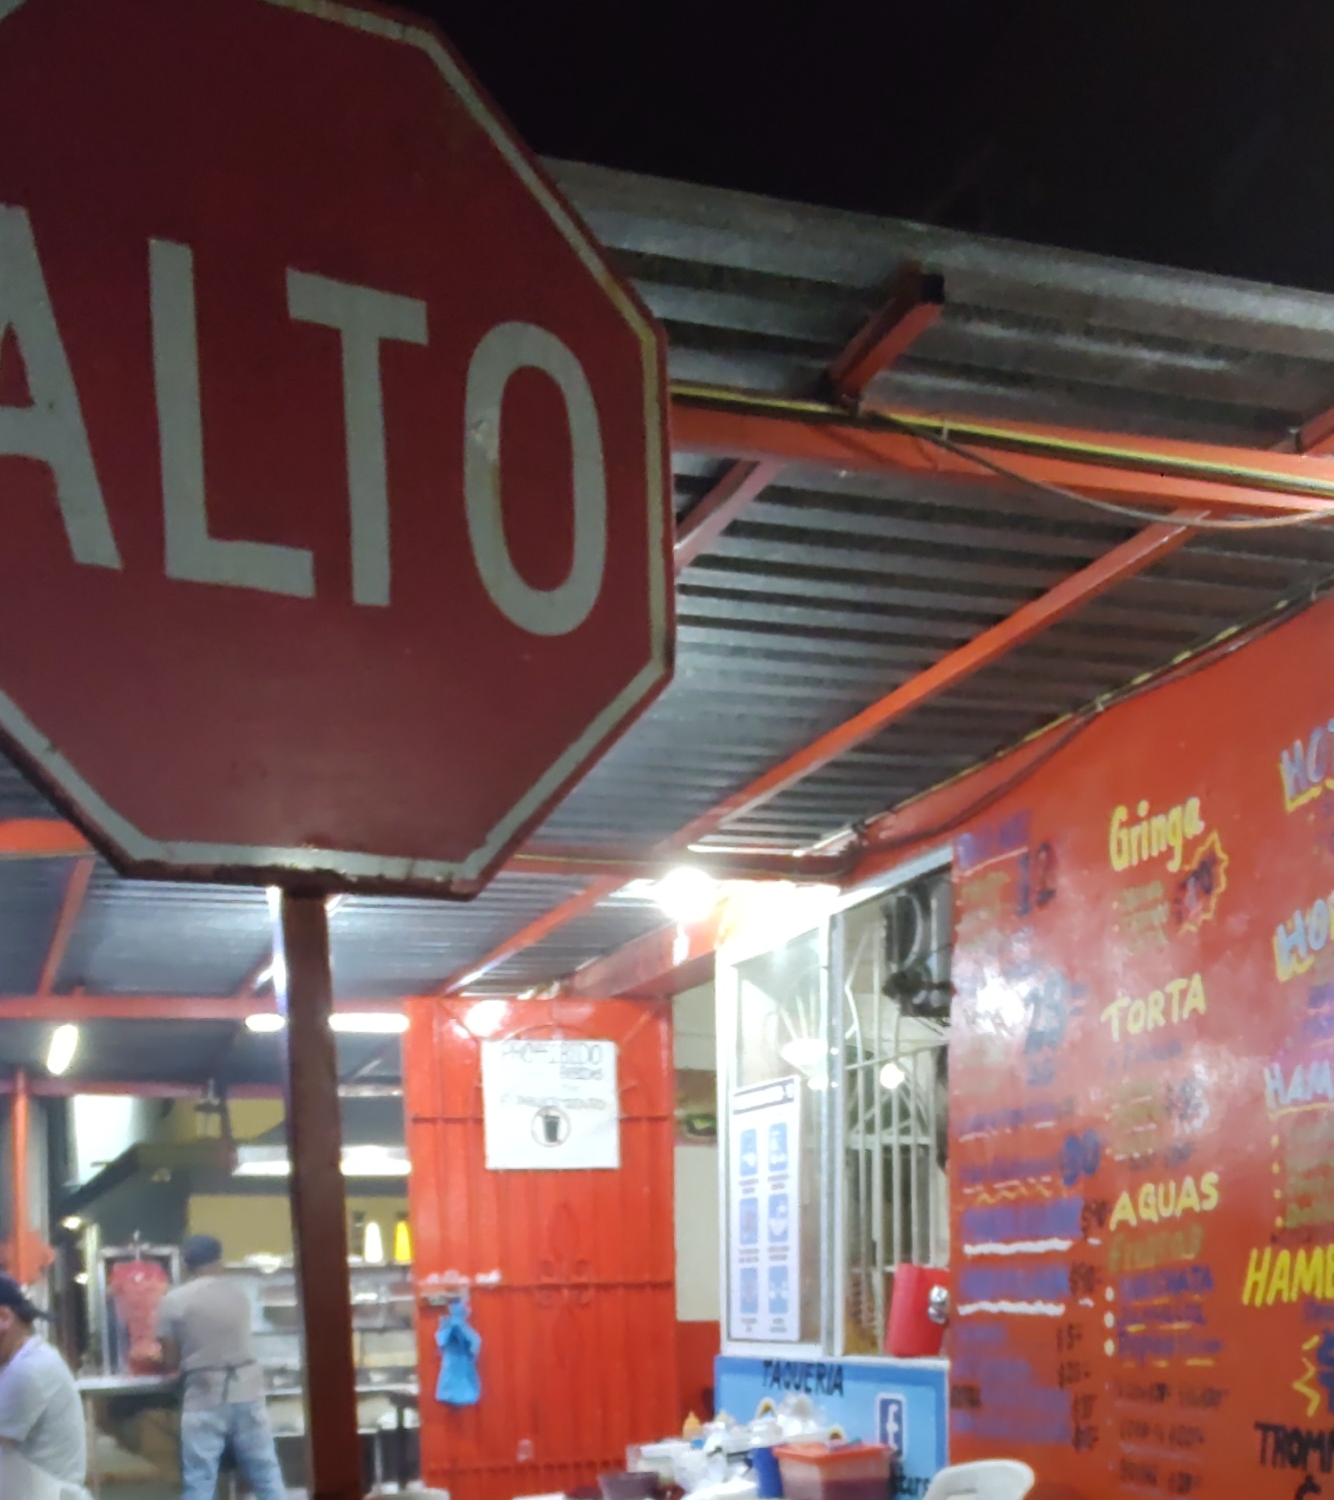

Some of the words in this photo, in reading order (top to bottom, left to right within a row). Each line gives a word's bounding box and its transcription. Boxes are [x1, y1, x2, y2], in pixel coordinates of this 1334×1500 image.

[1109, 797, 1206, 874] Gringa
[1100, 972, 1207, 1042] TORTA
[762, 1360, 844, 1397] TAQUERIA
